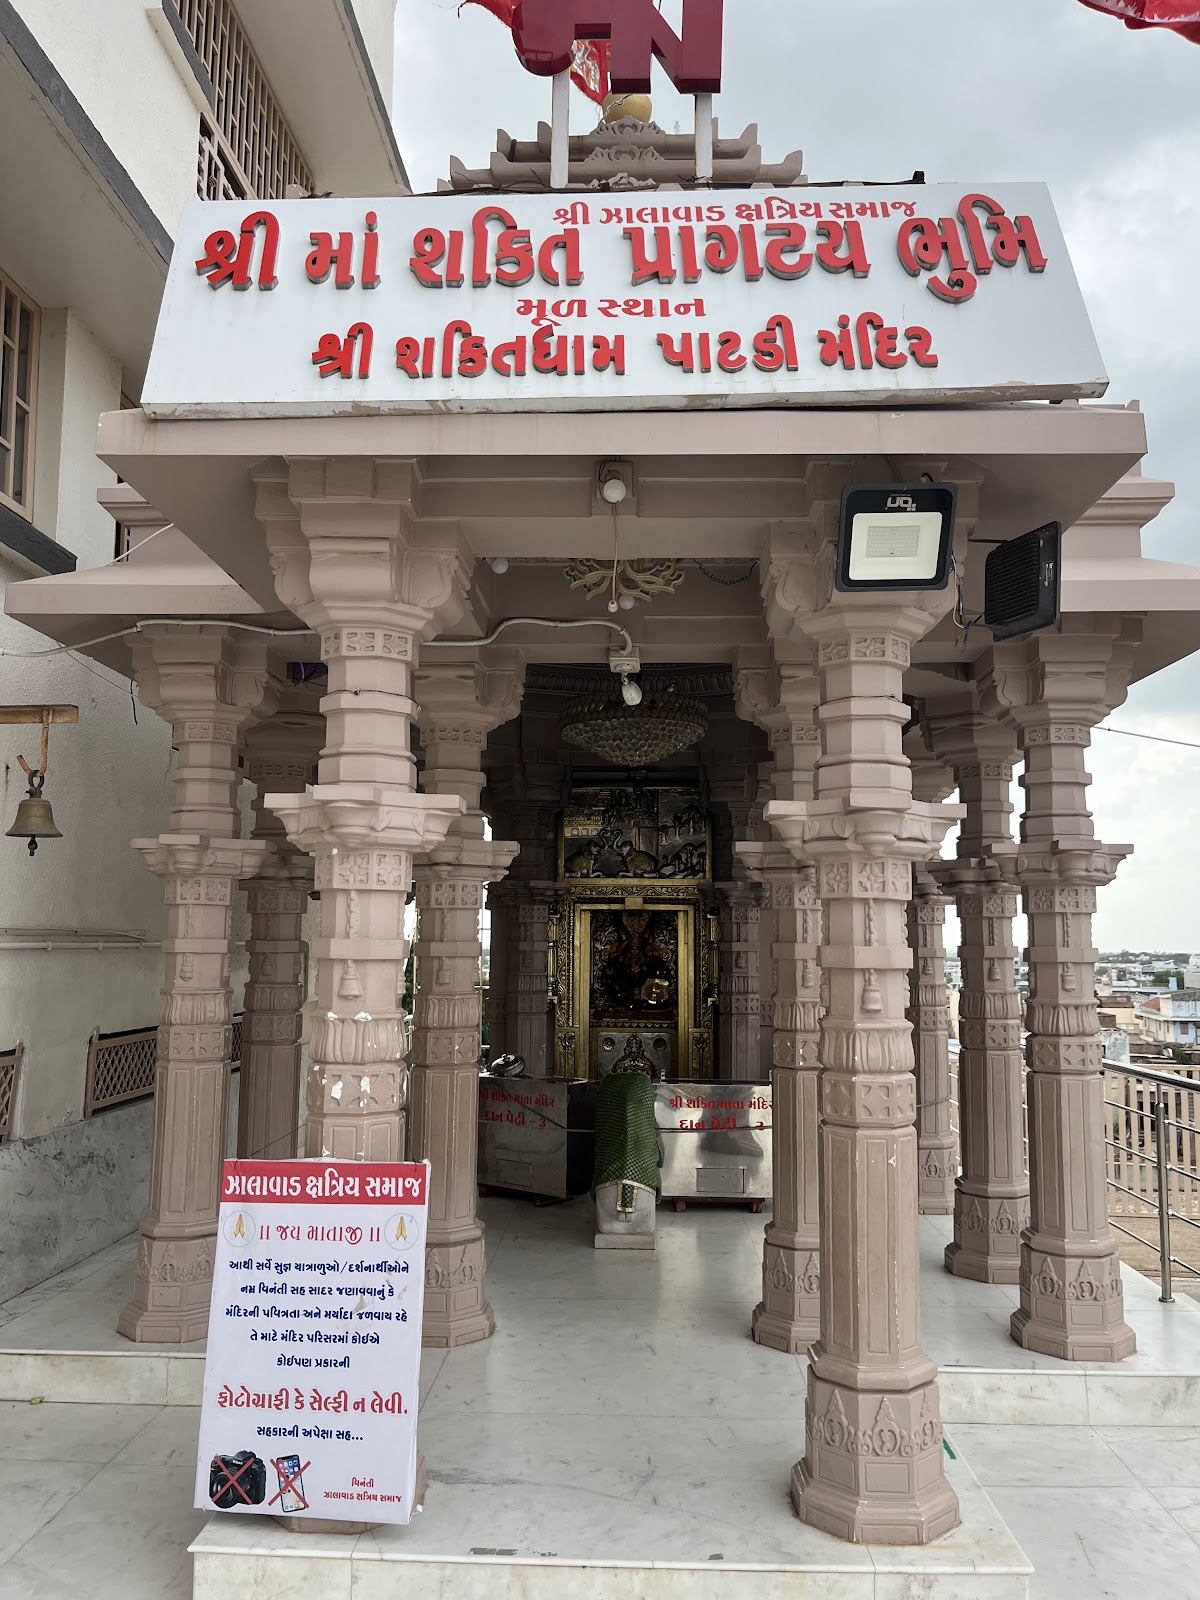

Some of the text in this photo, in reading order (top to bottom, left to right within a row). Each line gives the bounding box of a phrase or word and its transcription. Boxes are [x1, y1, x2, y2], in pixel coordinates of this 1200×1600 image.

[553, 196, 917, 225] શ્રી ઝાલાવાડ ક્ષત્રિય સમાજ
[195, 211, 280, 290] શ્રી
[305, 211, 381, 289] માં
[516, 298, 707, 327] મૂળ સ્થાન
[312, 321, 374, 379] શ્રી
[656, 314, 798, 373] પાટડી
[816, 311, 939, 370] મંદિર
[535, 1093, 555, 1107] મંદિર
[669, 1095, 683, 1109] શ્રી
[484, 1111, 503, 1122] દાન
[506, 1109, 525, 1127] પેટી
[225, 1168, 422, 1199] ઝાલાવાડ ક્ષત્રિય સમાજ
[276, 1225, 300, 1241] જય
[307, 1226, 363, 1245] માતાજી
[229, 1259, 253, 1270] આથી
[256, 1260, 271, 1271] સર્વે
[259, 1282, 287, 1295] વિનંતી
[291, 1287, 305, 1295] સહ
[308, 1287, 332, 1296] સાદર
[336, 1287, 385, 1300] જણાવવાનું
[388, 1285, 395, 1297] કે
[226, 1305, 407, 1322] મંદિરની પવિત્રતા અને મર્યાદા જળવાય રહે
[250, 1329, 380, 1345] તે માટે મંદિર પરિસરમાં કોઈએ
[276, 1354, 350, 1368] કોઈપણ પ્રકારની
[217, 1385, 290, 1410] ફોટોગ્રાફી
[294, 1388, 305, 1410] કે
[309, 1389, 349, 1413] સેલ્ફી
[353, 1399, 365, 1413] ન
[257, 1425, 299, 1438] સહકારની
[302, 1427, 332, 1440] અપેક્ષા
[352, 1477, 374, 1488] વિનંતી
[323, 1491, 355, 1500] ઝાલાવાડ
[380, 1494, 402, 1503] સમાજ
